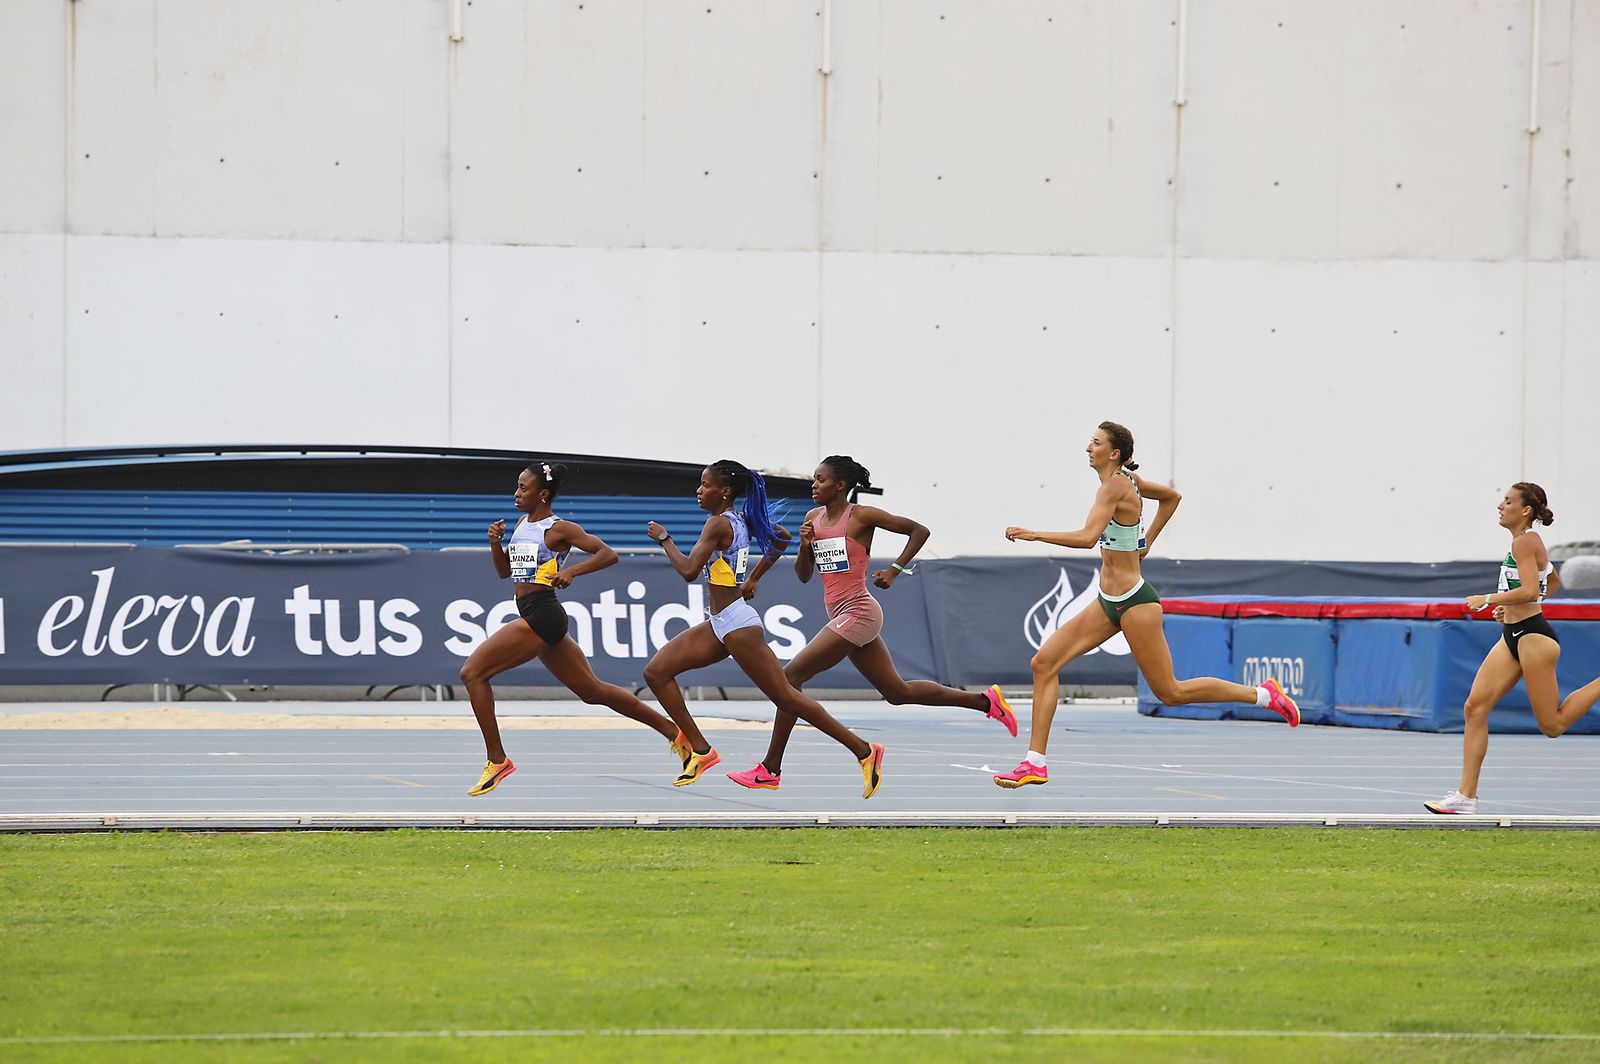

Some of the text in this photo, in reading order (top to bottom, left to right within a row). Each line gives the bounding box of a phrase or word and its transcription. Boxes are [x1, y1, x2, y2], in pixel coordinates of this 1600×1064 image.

[814, 549, 845, 558] PROTICH
[37, 566, 256, 657] eleva
[284, 584, 423, 657] tus
[444, 581, 807, 660] sentids
